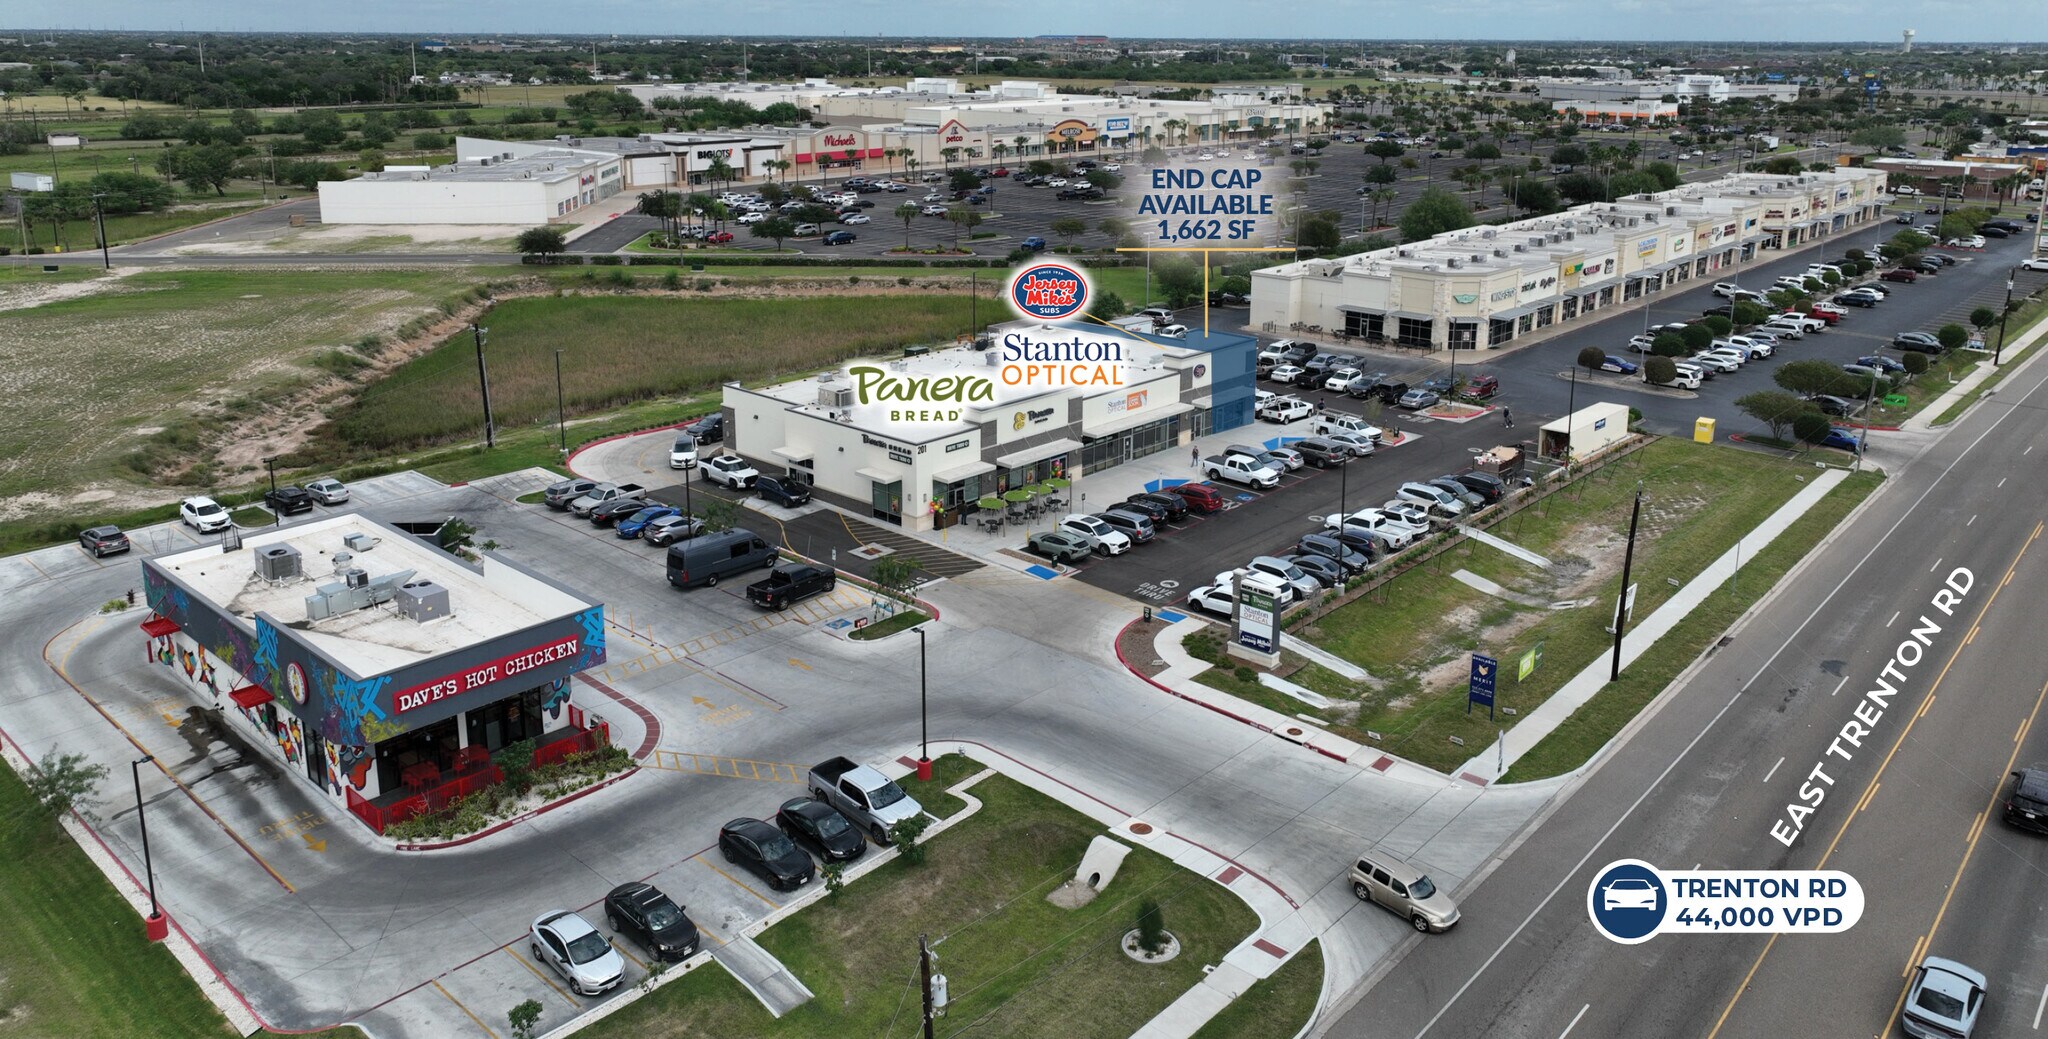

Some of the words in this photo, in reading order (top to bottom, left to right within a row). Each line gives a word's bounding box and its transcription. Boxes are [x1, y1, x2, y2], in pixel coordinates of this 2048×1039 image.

[946, 135, 963, 143] petco
[888, 444, 912, 455] BREAD
[917, 445, 927, 455] 201
[1133, 587, 1165, 600] THRU
[1139, 582, 1176, 597] DRIVE
[1243, 612, 1268, 625] OPTICAL
[1472, 656, 1496, 666] AVAILABLE
[399, 679, 458, 712] DAVE'S
[465, 665, 498, 689] HOT
[505, 639, 578, 676] CHICKEN
[1473, 676, 1492, 685] MERIT
